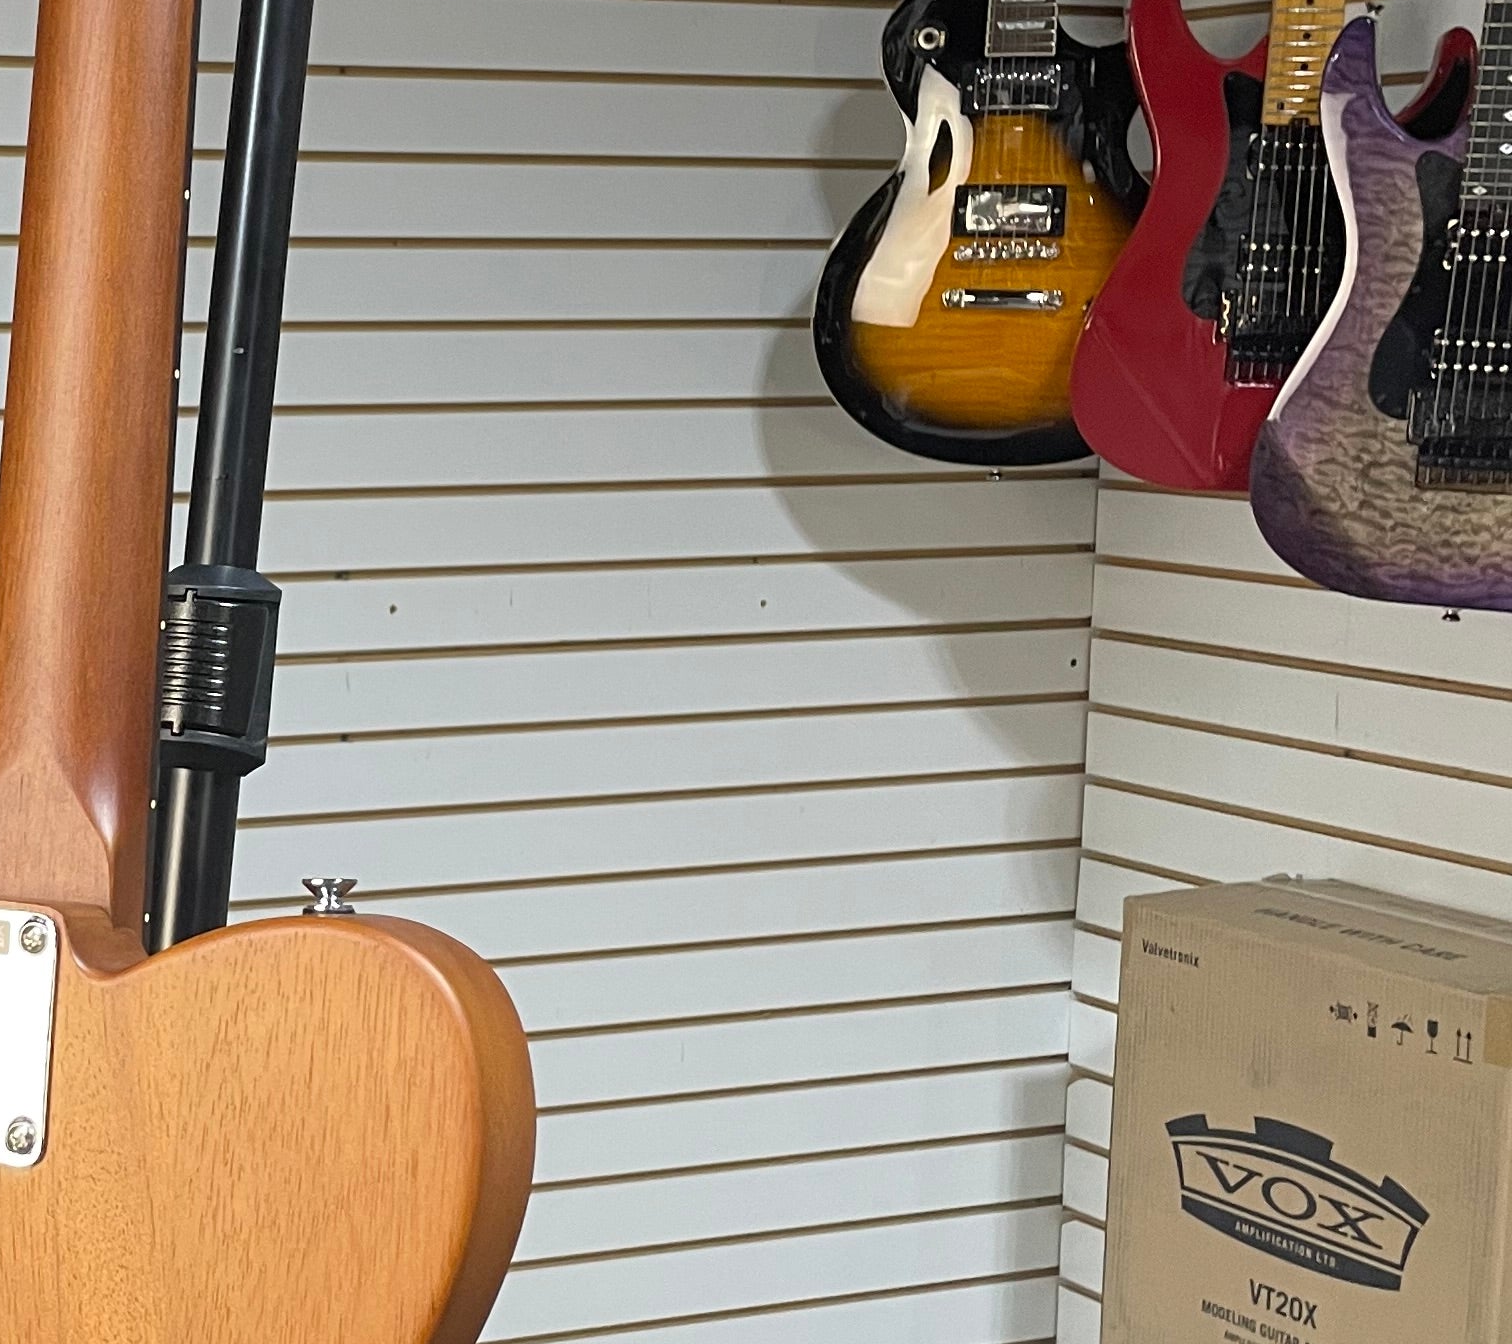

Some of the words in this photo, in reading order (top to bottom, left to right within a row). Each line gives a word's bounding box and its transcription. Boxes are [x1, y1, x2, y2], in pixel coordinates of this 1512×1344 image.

[1196, 1150, 1384, 1250] VOX
[1234, 1220, 1313, 1261] AMPLIFICATION
[1249, 1278, 1318, 1330] VT20X
